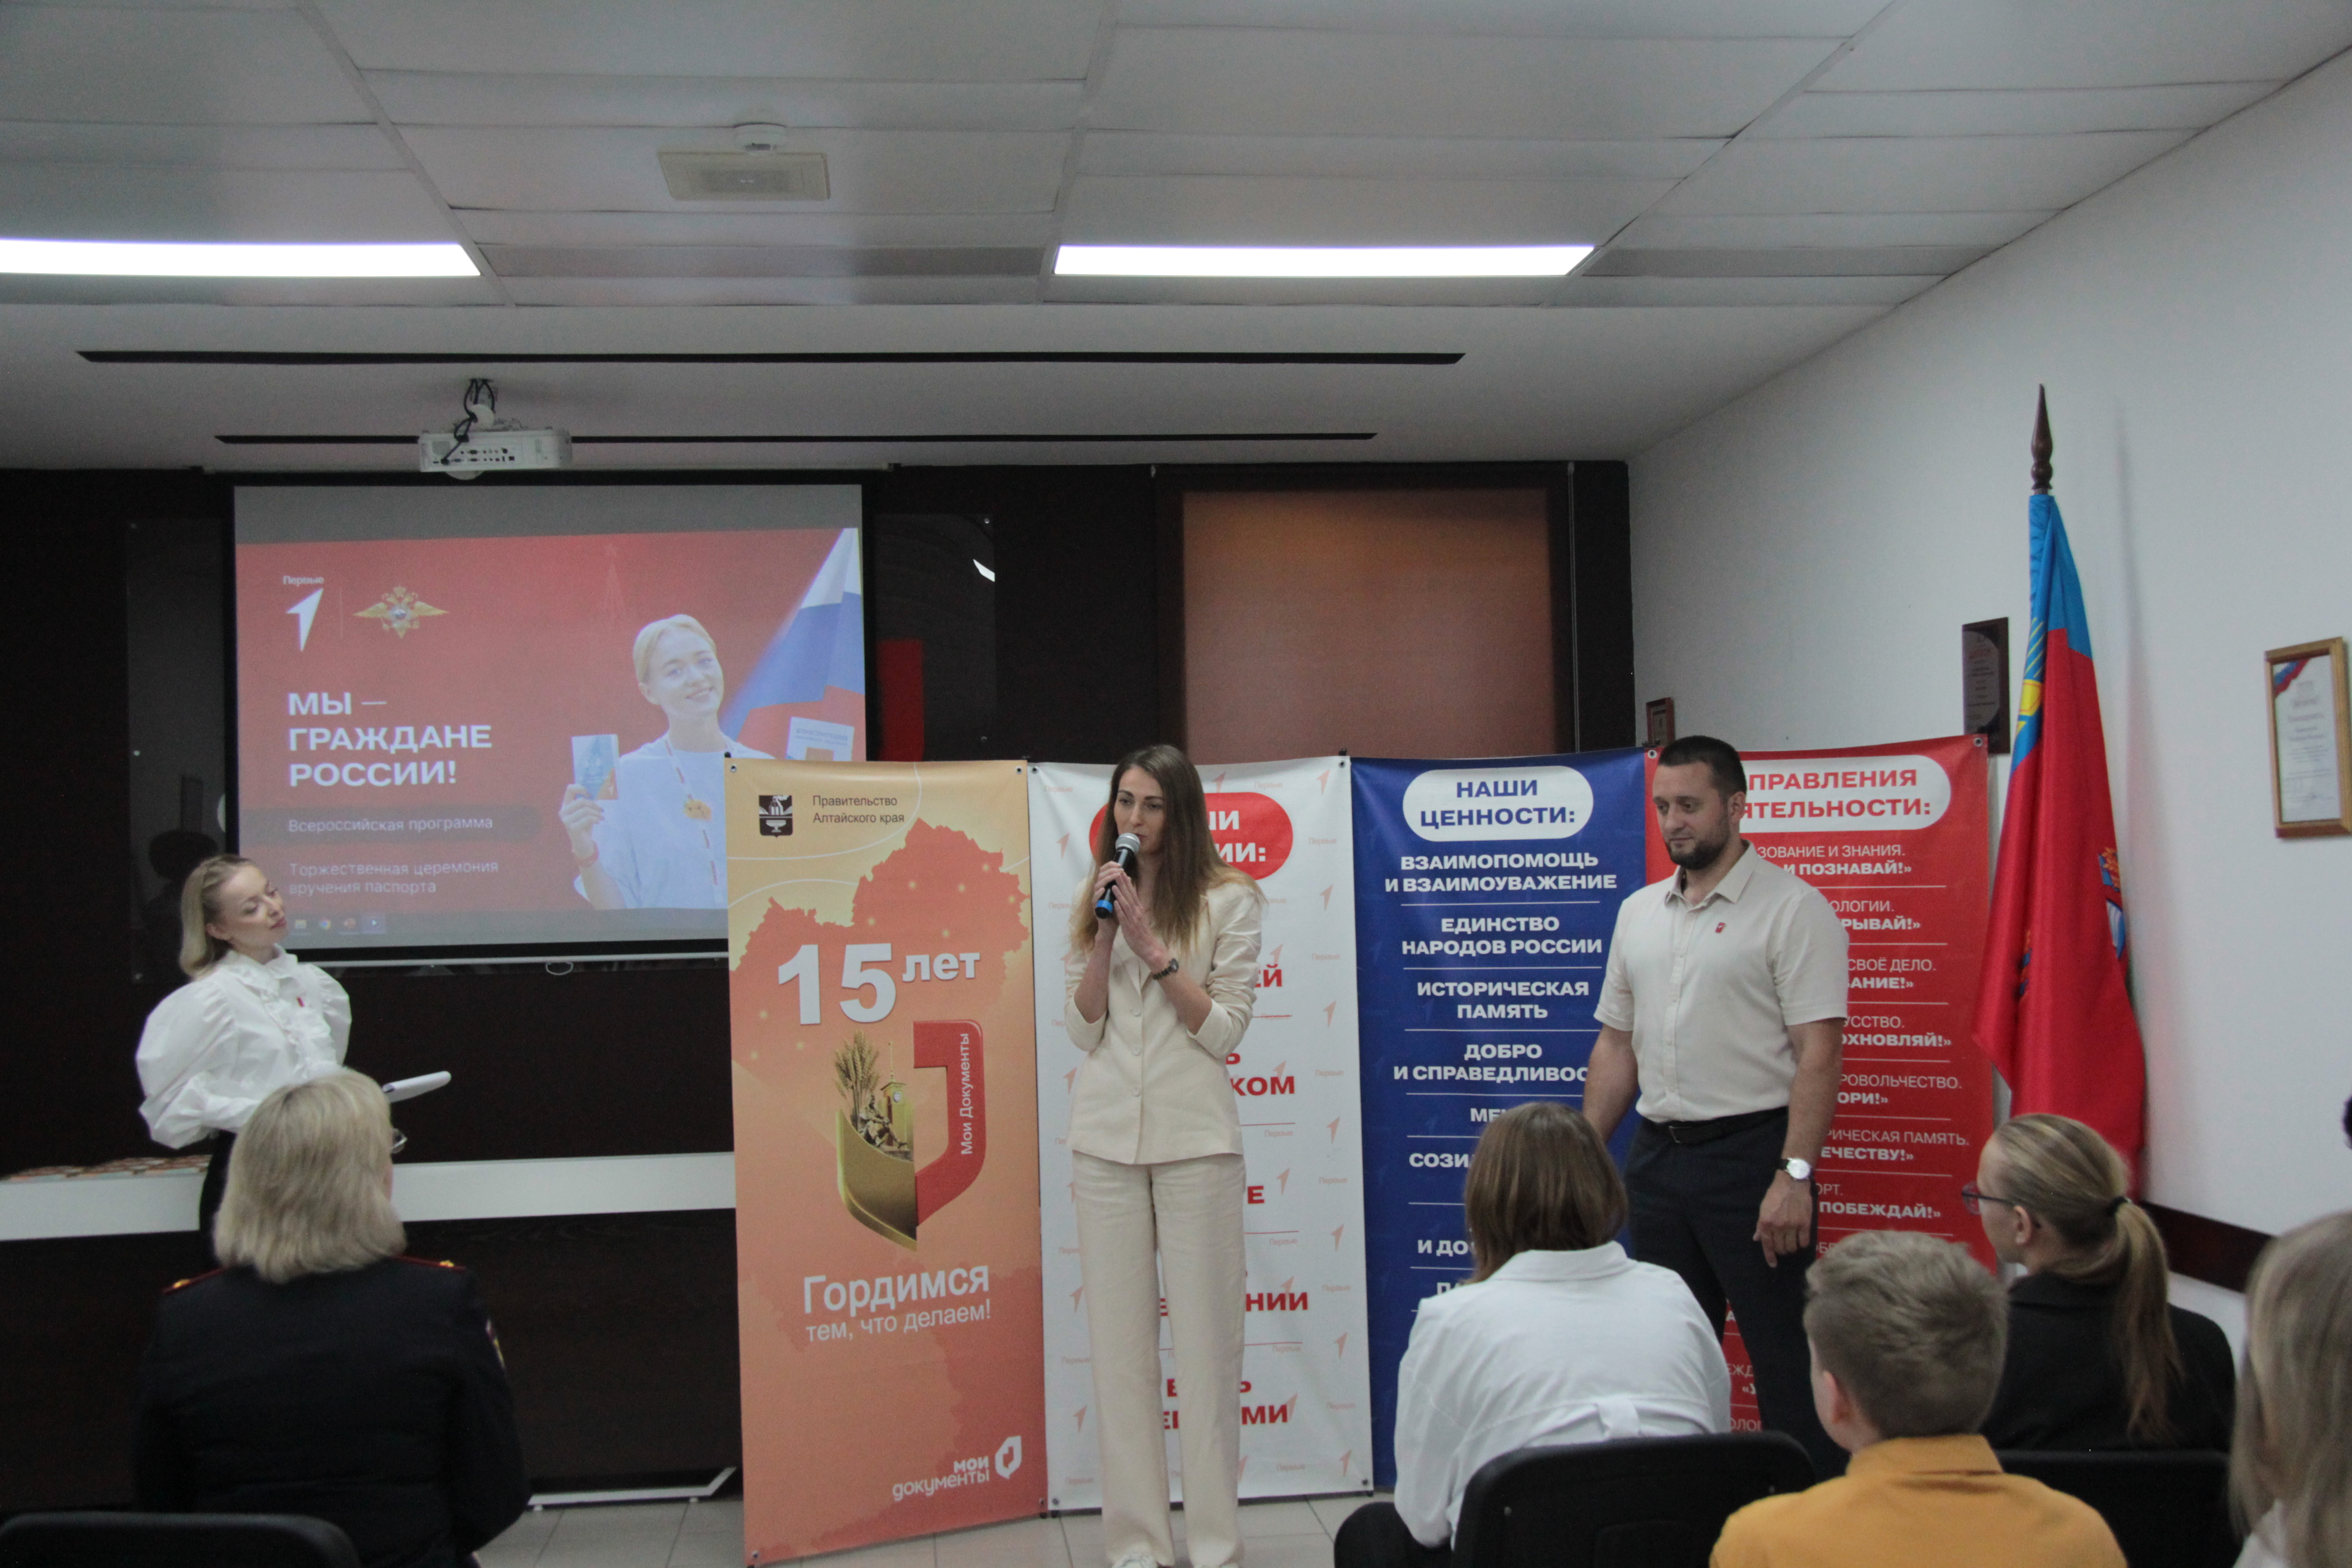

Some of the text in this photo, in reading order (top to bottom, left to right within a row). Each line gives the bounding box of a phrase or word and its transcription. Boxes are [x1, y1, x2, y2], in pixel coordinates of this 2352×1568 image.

[283, 575, 324, 587] Первые
[288, 692, 352, 715] МЫ
[289, 725, 492, 754] ГРАЖДАНЕ
[289, 760, 456, 787] РОССИИ!
[1749, 769, 1917, 791] ПРАВЛЕНИЯ
[1456, 779, 1538, 798] НАШИ
[813, 795, 897, 808] Правительство
[289, 818, 493, 833] Всероссийская программа
[813, 812, 904, 825] Алтайского края
[1421, 807, 1575, 829] ЦЕННОСТИ:
[1758, 845, 1906, 858] ЗОВАНИЕ И ЗНАНИЯ.
[289, 861, 499, 877] Торжественная церемония
[1401, 853, 1599, 870] ВЗАИМОПОМОЩЬ
[1799, 859, 1911, 875] ПОЗНАВАЙ!»
[289, 881, 436, 897] вручения паспорта
[1385, 874, 1617, 892] И ВЗАИМОУВАЖЕНИЕ
[1830, 901, 1894, 912] ОЛОГИИ.
[1441, 916, 1559, 934] ЕДИНСТВО
[1842, 916, 1920, 930] РЫВАЙ!»
[1402, 939, 1602, 957] НАРОДОВ РОССИИ
[1889, 960, 1936, 972] ДЕЛО.
[778, 943, 980, 1025] 15 лет
[1417, 982, 1589, 996] ИСТОРИЧЕСКАЯ
[1458, 1005, 1548, 1019] ПАМЯТЬ
[1843, 1016, 1904, 1028] УССТВО.
[1464, 1044, 1542, 1060] ДОБРО
[1393, 1066, 1588, 1083] И СПРАВЕДЛИВОС
[959, 1033, 973, 1155] Мои Документы
[1838, 1092, 1888, 1104] ОРИ!»
[1904, 1132, 1969, 1145] ПАМЯТЬ.
[1821, 1147, 1914, 1161] ЕЧЕСТВУ!»
[1819, 1202, 1941, 1219] ПОБЕЖДАЙ!»
[804, 1265, 990, 1317] Гордимся
[806, 1299, 991, 1342] тем, что делаем!
[953, 1456, 989, 1473] мои
[892, 1469, 990, 1501] документы
